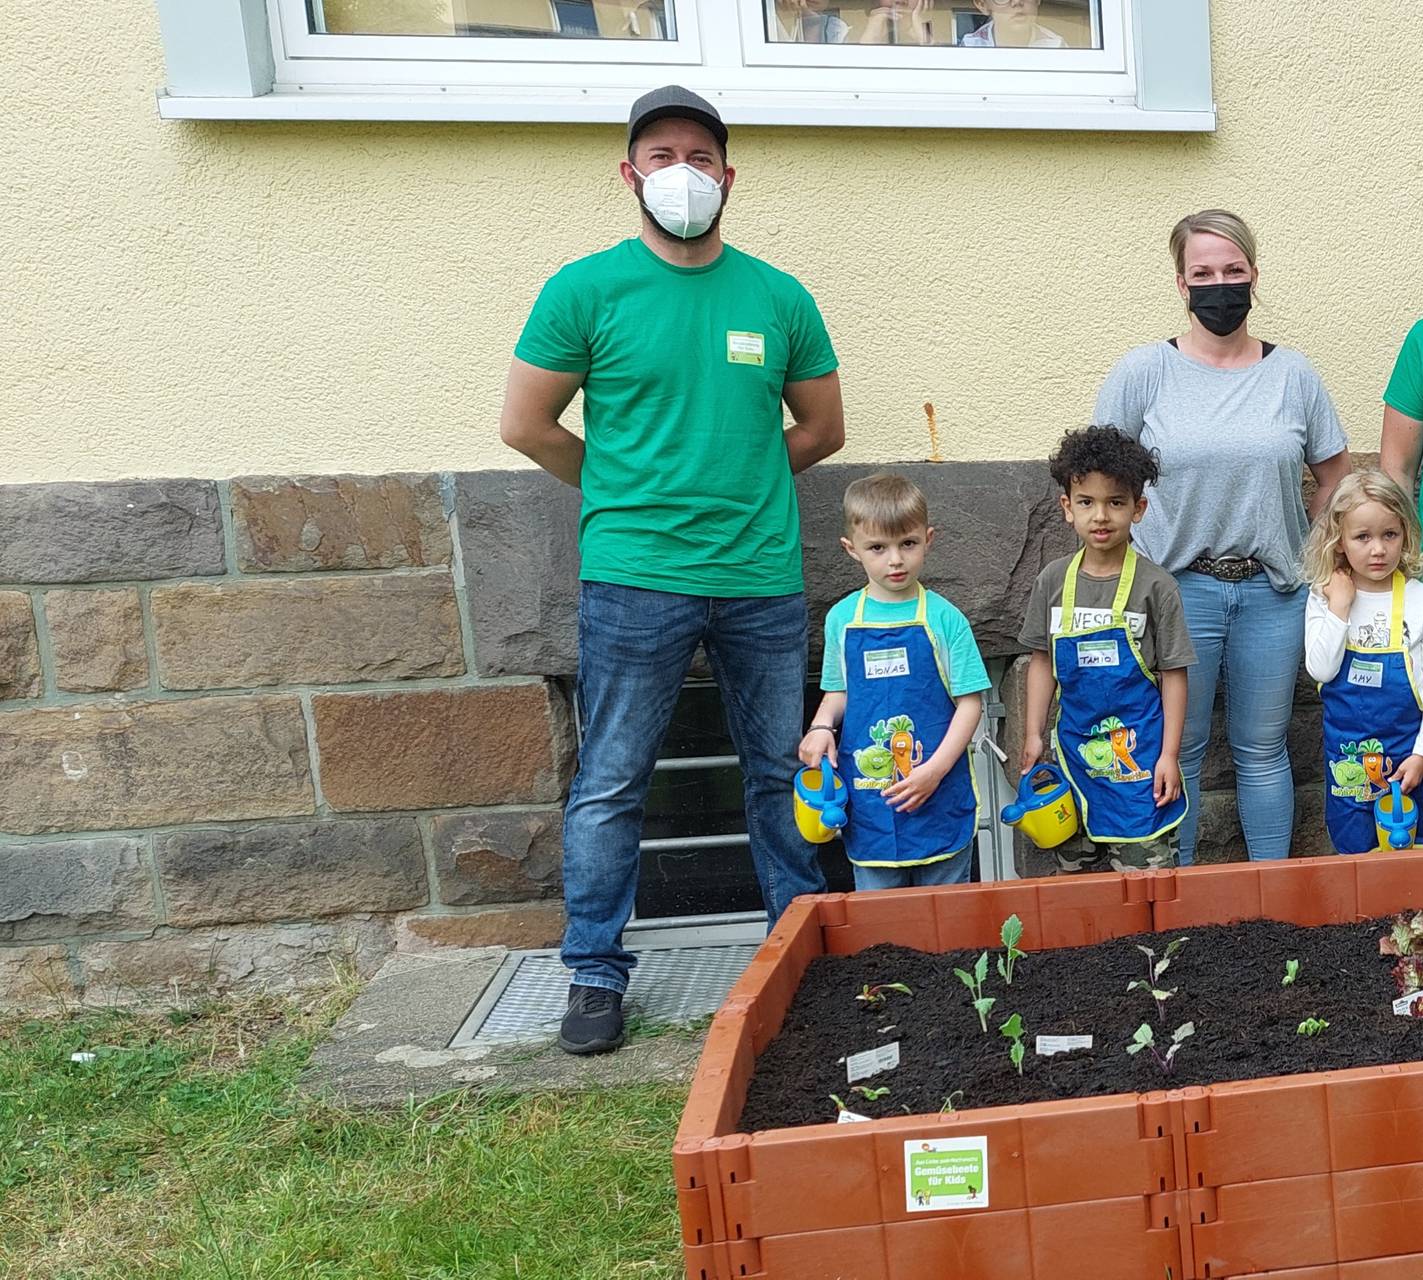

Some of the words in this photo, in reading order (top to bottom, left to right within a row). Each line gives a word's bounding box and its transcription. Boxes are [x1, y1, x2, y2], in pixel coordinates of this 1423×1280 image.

[1352, 673, 1372, 683] AMY
[914, 1164, 980, 1177] Gemüsebeete
[928, 1176, 943, 1186] für
[944, 1175, 967, 1185] Kids
